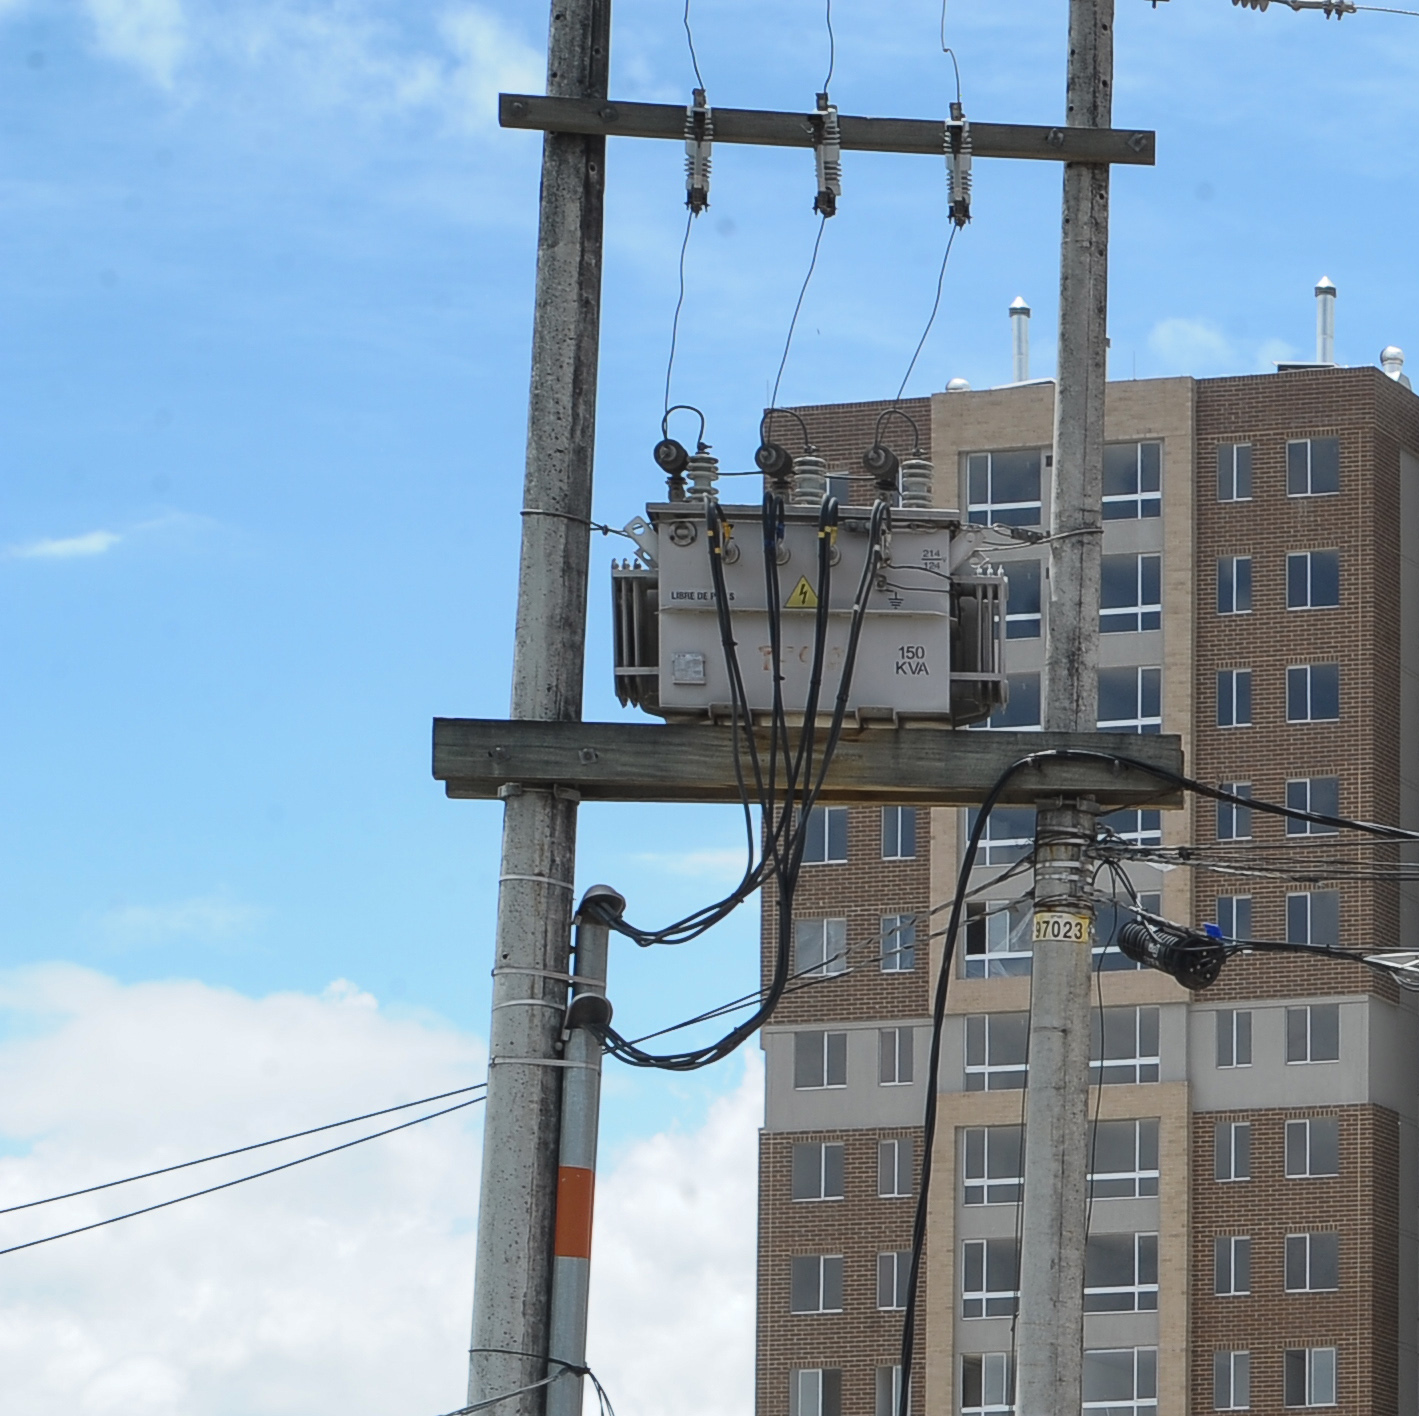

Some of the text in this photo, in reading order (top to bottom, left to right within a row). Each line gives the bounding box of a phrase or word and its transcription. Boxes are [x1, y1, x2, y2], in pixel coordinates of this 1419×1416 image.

[922, 549, 941, 558] 214
[671, 591, 695, 600] LIBRE
[697, 591, 708, 600] DE
[898, 645, 925, 660] 150
[895, 661, 930, 676] KVA
[1035, 920, 1083, 940] 97023
